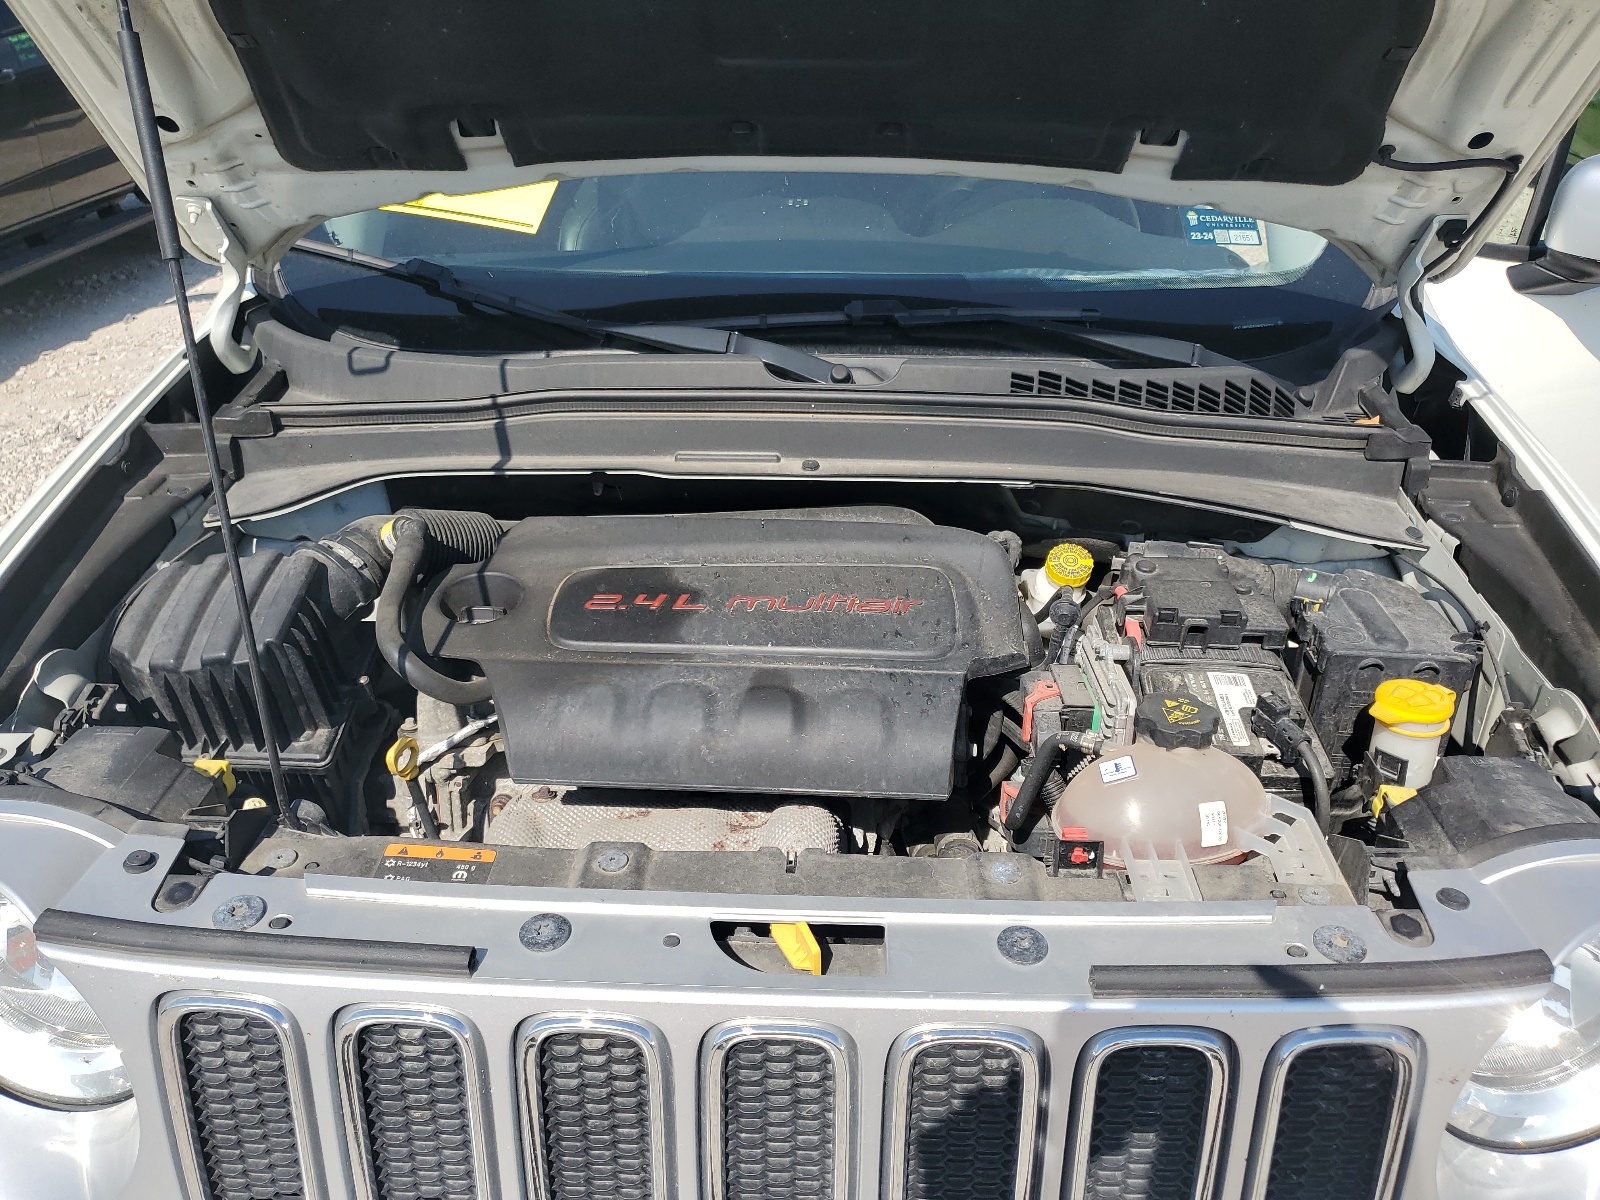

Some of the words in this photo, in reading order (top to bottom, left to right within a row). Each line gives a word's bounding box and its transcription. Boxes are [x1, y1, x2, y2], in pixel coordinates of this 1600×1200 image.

[1199, 215, 1255, 223] CEDARVILLE
[1190, 232, 1214, 240] 23-24
[726, 594, 923, 614] multiair
